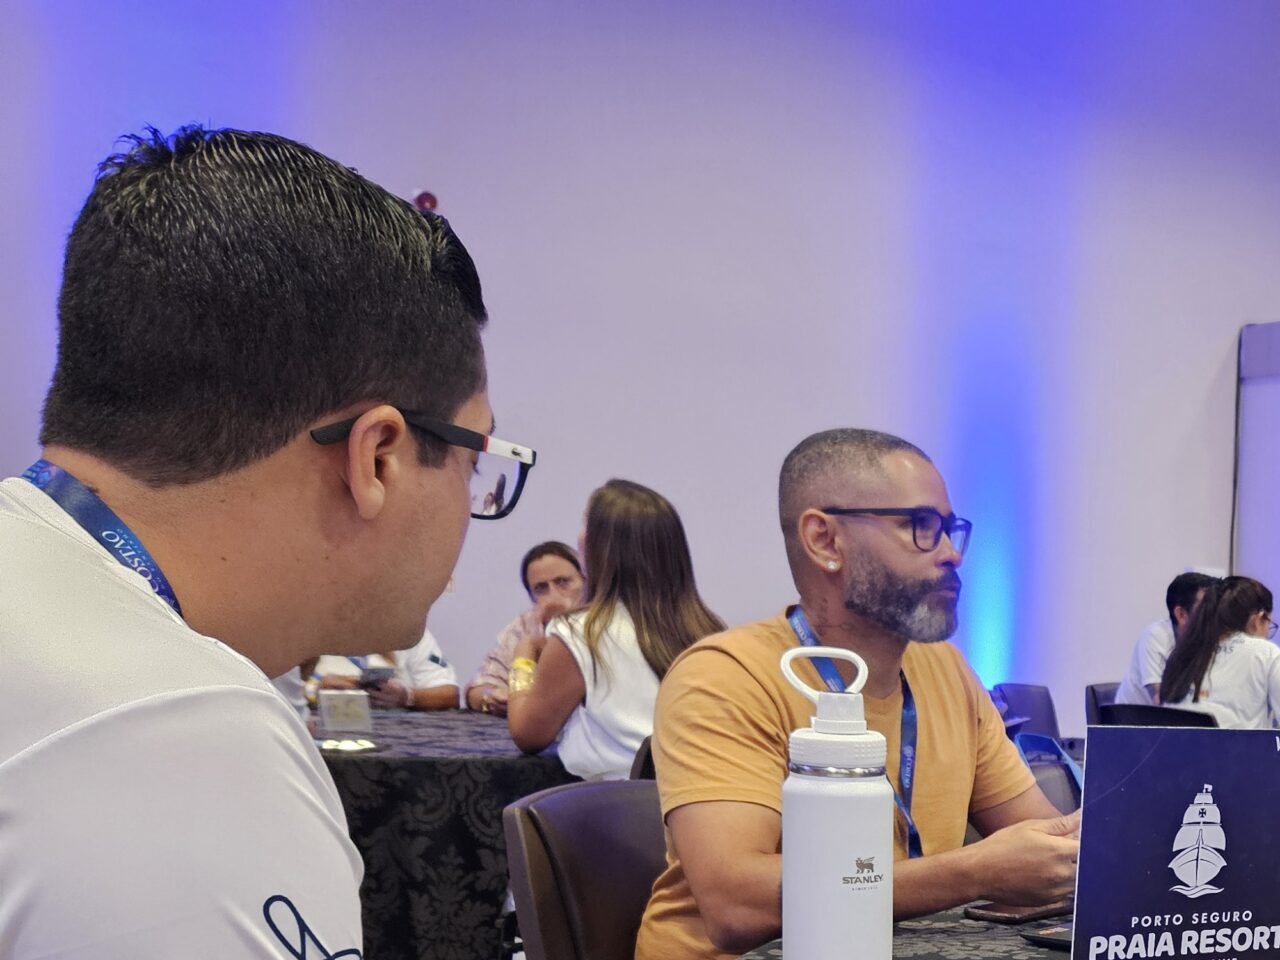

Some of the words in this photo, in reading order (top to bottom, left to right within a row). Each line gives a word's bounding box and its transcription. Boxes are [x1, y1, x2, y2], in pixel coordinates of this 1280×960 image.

[842, 874, 884, 885] STANLEY
[1131, 914, 1183, 928] PORTO
[1191, 910, 1253, 925] SEGURO
